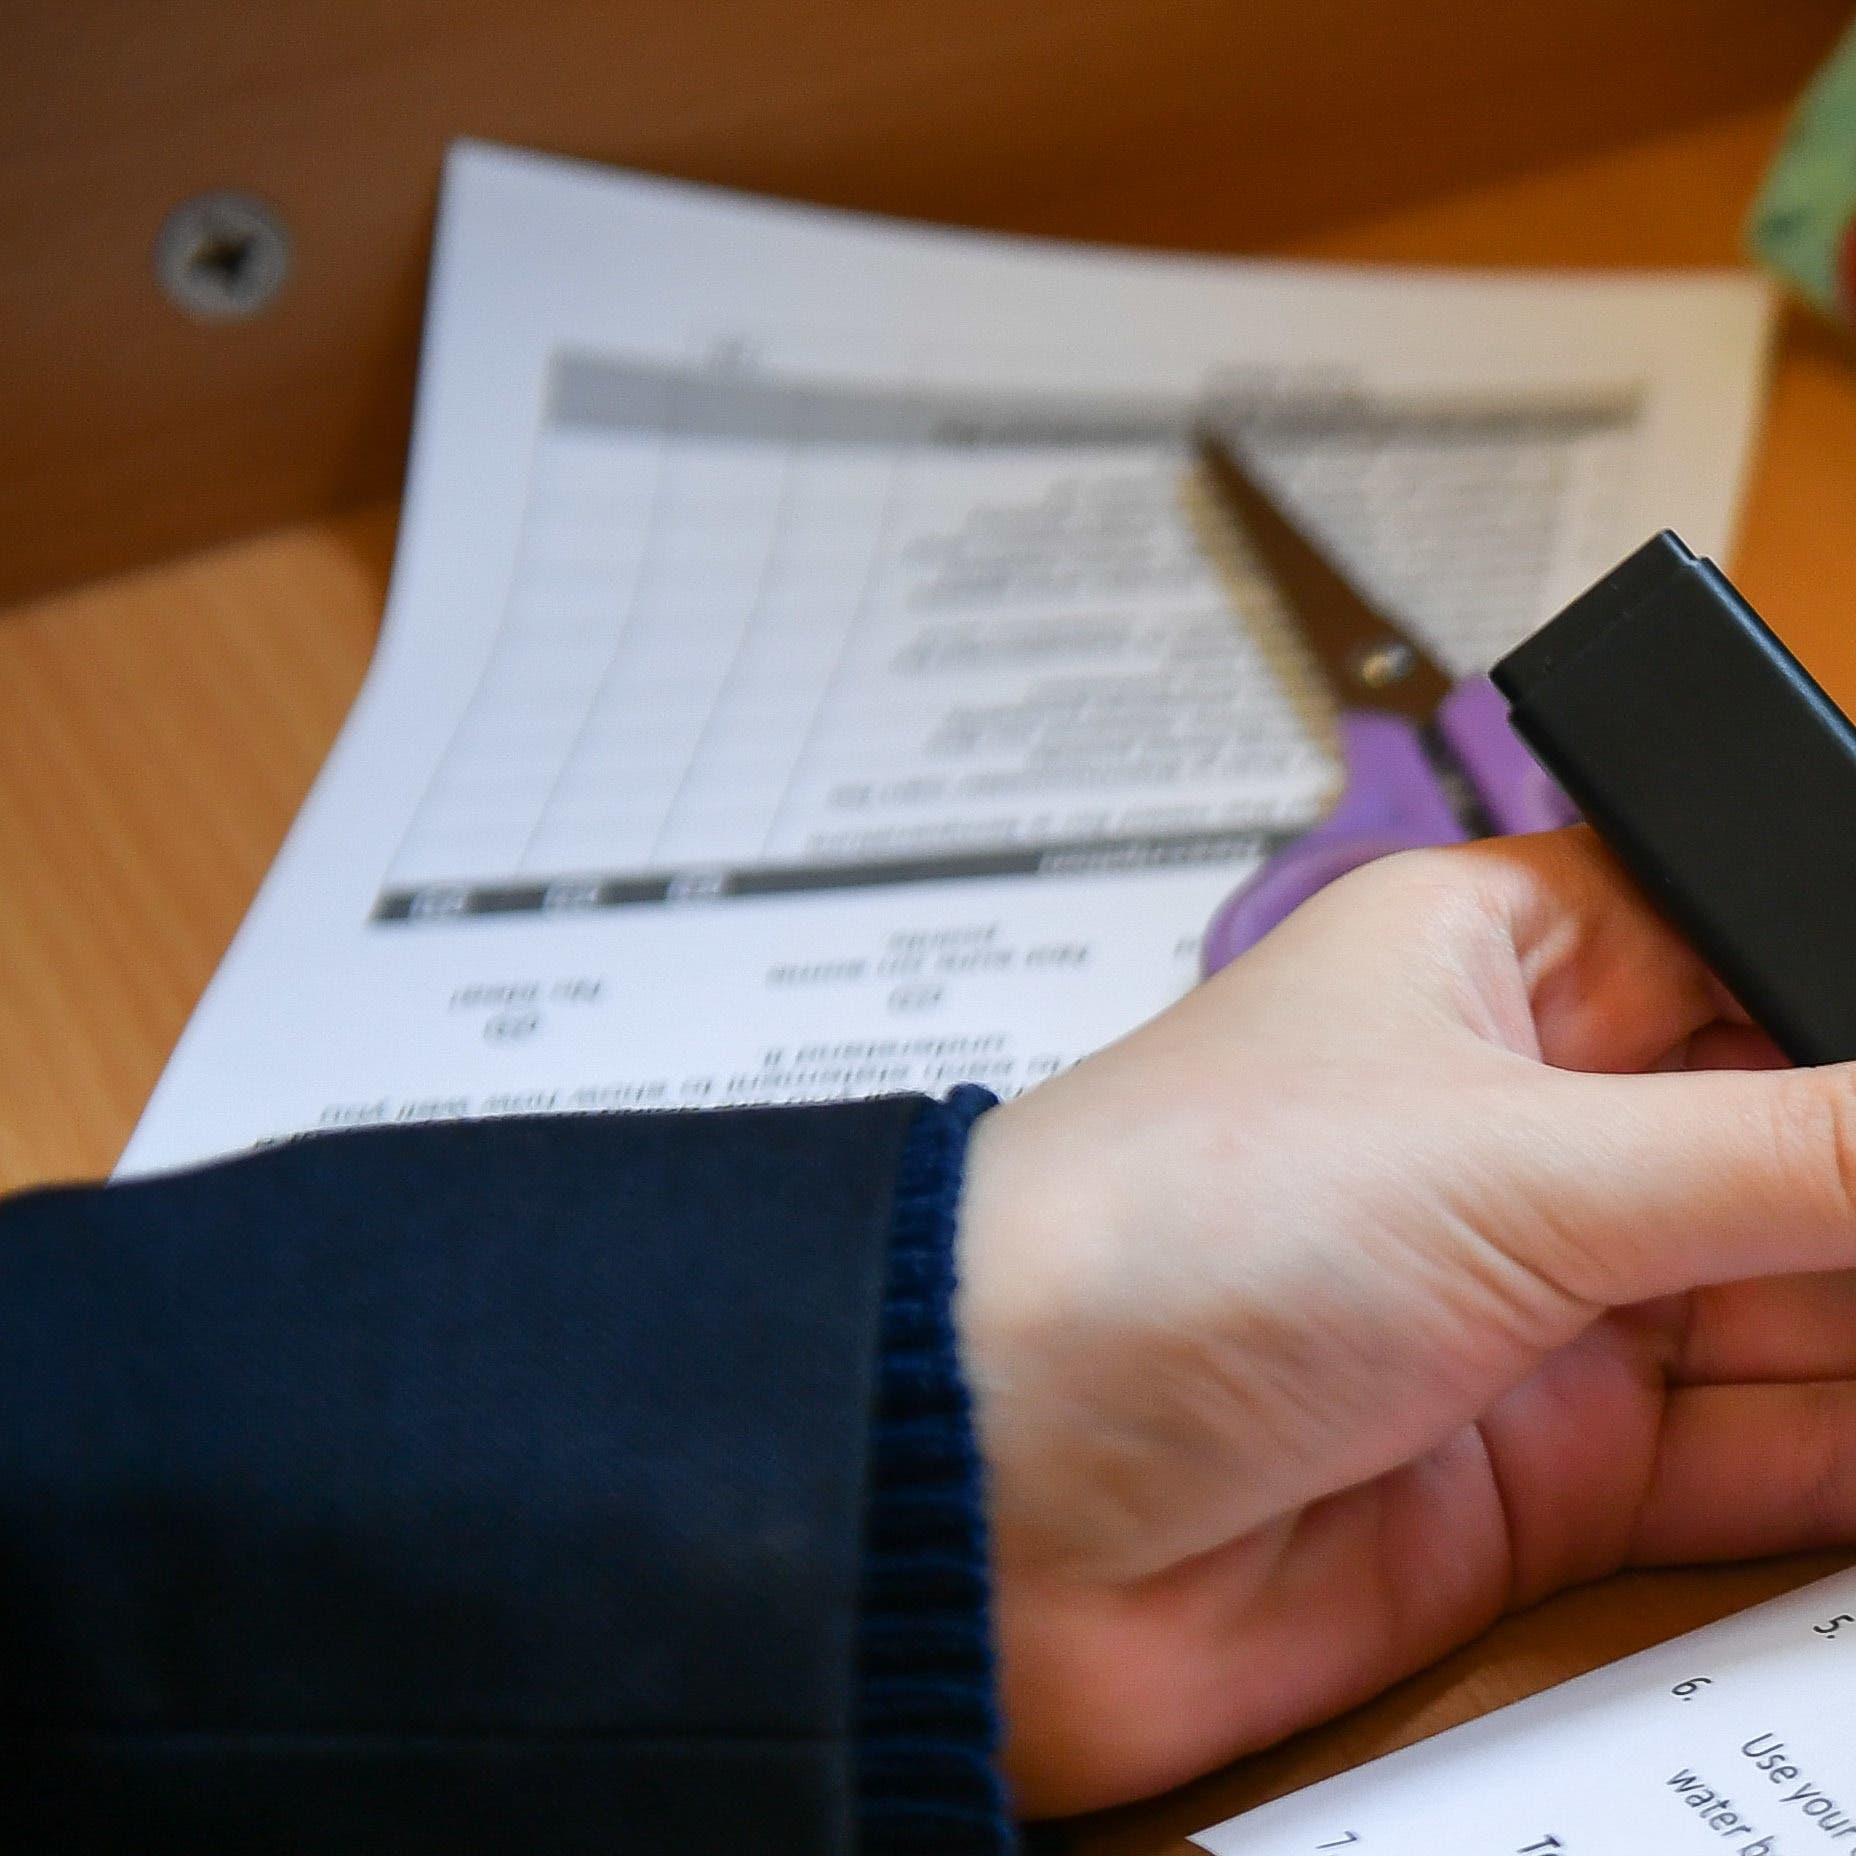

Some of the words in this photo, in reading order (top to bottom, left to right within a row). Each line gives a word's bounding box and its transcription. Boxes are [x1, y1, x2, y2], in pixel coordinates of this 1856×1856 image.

[1812, 1615, 1855, 1640] 5.
[1670, 1678, 1713, 1702] 6.
[1740, 1733, 1801, 1785] Use
[1665, 1769, 1754, 1837] water
